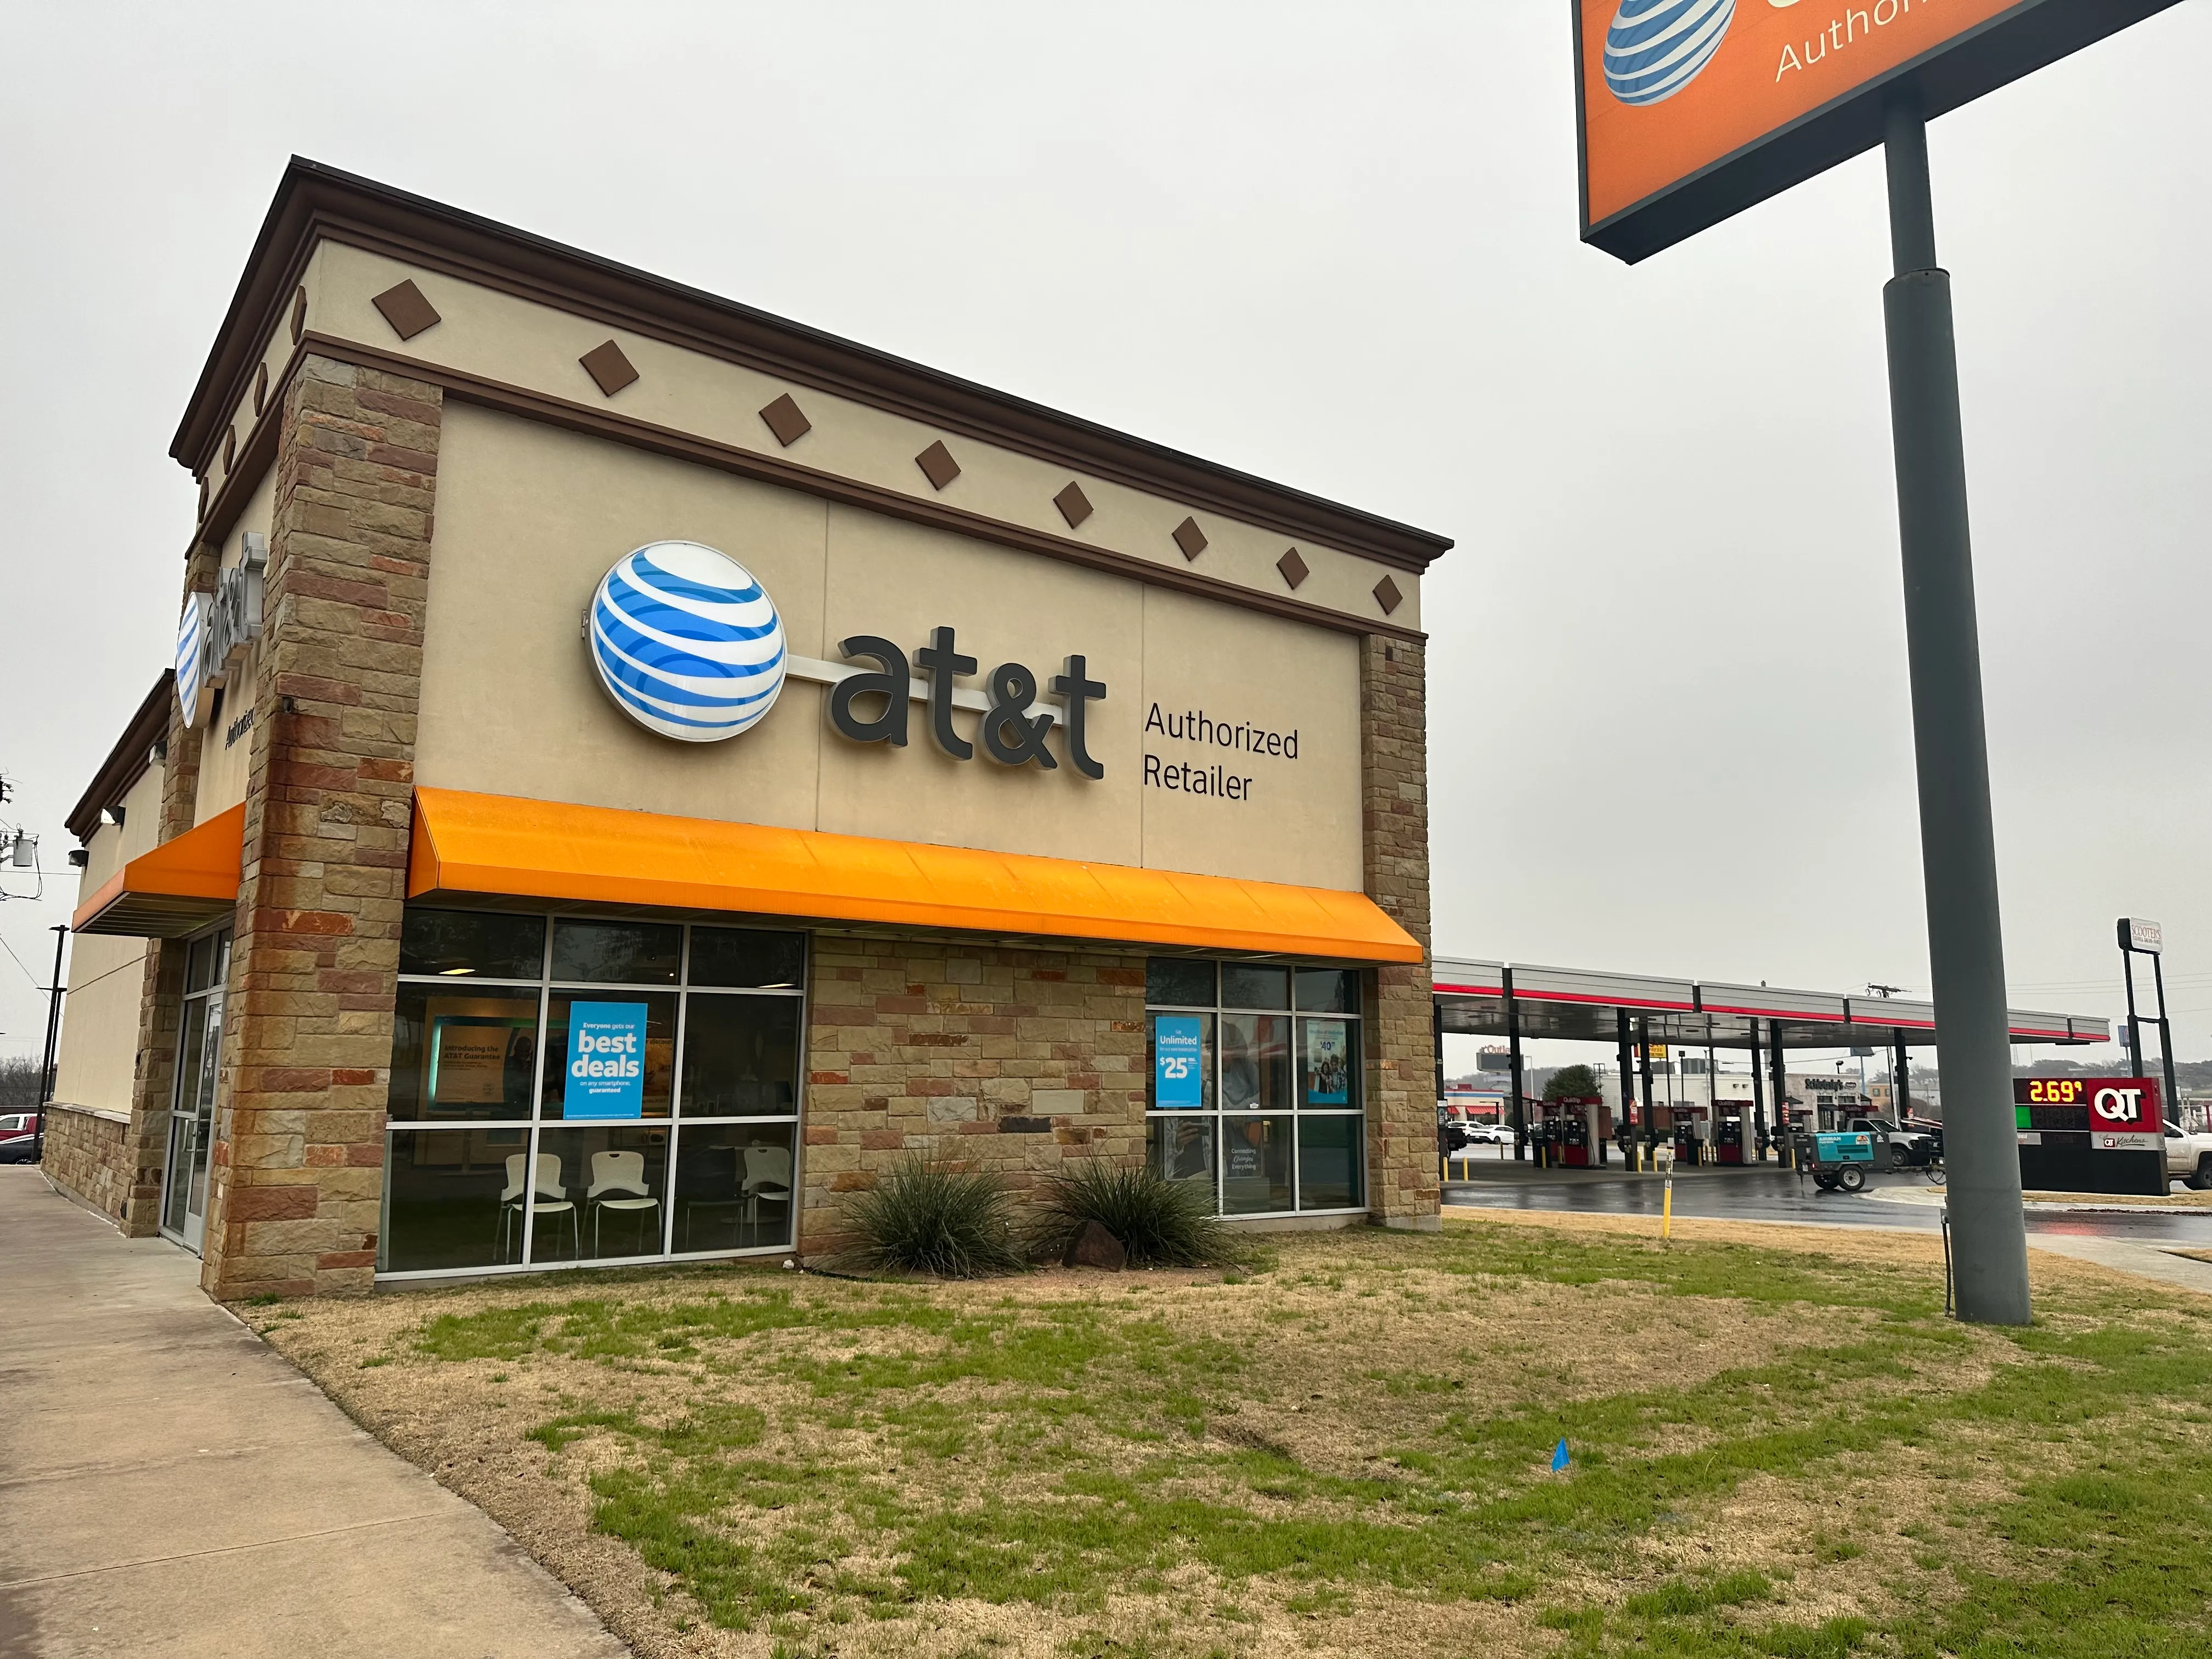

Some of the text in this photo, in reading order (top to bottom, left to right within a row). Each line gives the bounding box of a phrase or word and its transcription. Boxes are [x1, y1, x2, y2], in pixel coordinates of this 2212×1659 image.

[827, 625, 1107, 781] at&t
[1144, 702, 1298, 760] Authorized
[1144, 754, 1253, 801] Retailer
[444, 1045, 485, 1053] Introducing
[578, 1030, 636, 1053] best
[1160, 1035, 1197, 1045] Unlimited
[571, 1054, 639, 1077] deals
[1160, 1057, 1188, 1079] $25
[2094, 1088, 2141, 1121] QT
[2116, 1135, 2149, 1148] Kitchens
